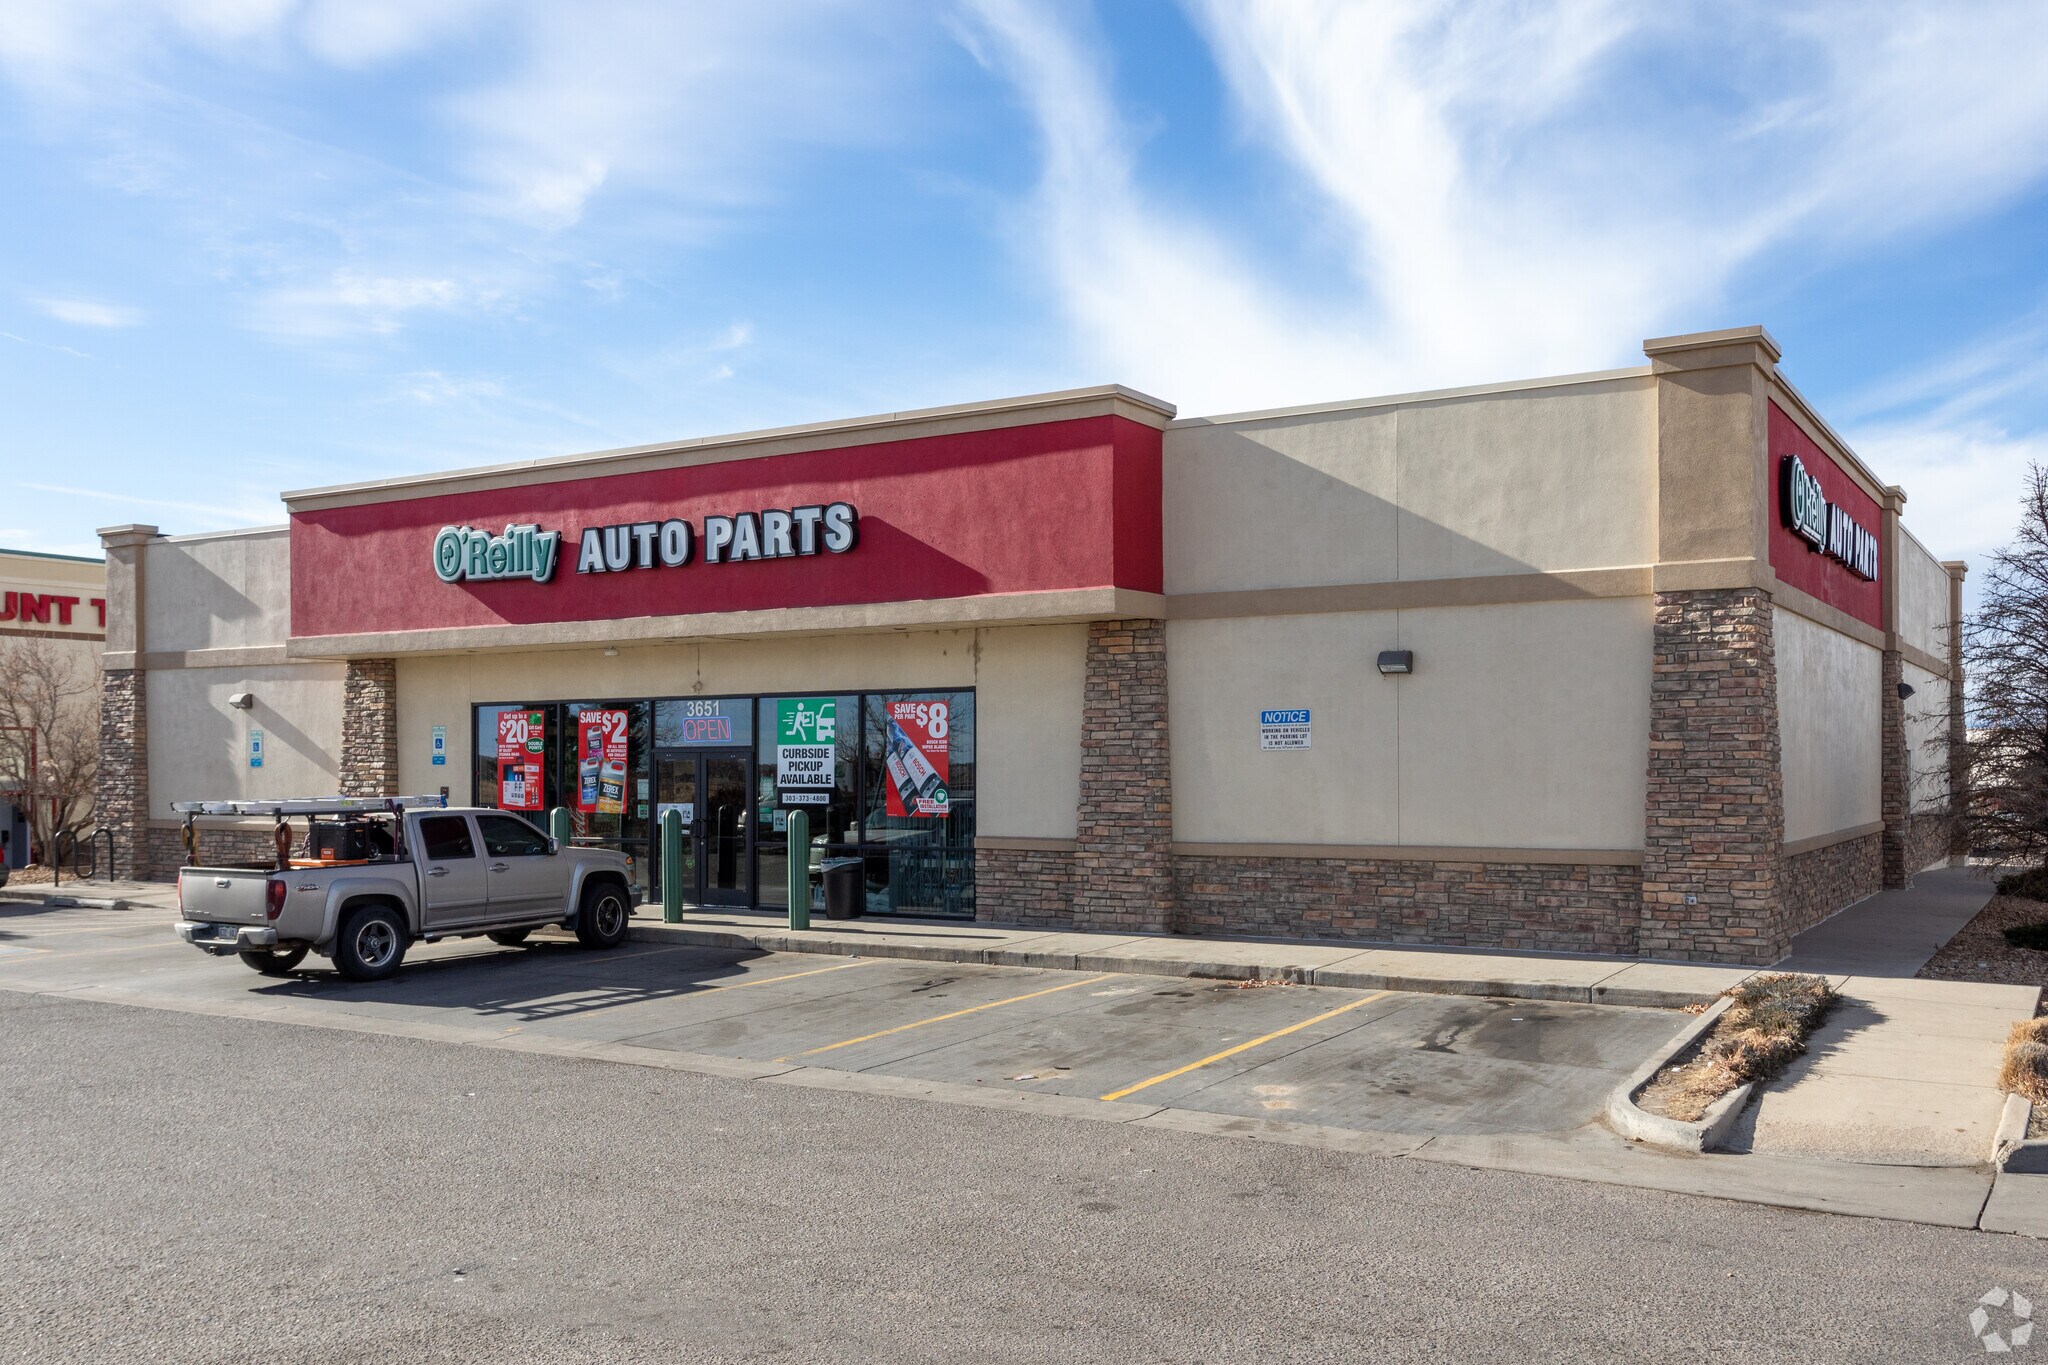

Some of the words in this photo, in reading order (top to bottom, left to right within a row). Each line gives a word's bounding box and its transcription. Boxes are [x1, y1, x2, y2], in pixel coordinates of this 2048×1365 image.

[436, 525, 557, 582] O'Reilly
[577, 518, 694, 574] AUTO
[704, 501, 857, 564] PARTS
[1830, 503, 1853, 566] AUTO
[1855, 522, 1878, 582] PARTS
[687, 700, 719, 716] 3651
[1264, 711, 1307, 722] NOTICE
[580, 712, 601, 723] SAVE
[602, 712, 627, 743] $2
[685, 719, 730, 740] OPEN
[894, 703, 916, 713] SAVE
[916, 703, 948, 738] $8
[500, 719, 528, 743] $20
[782, 748, 829, 758] CURBSIDE
[788, 761, 823, 771] PICKUP
[895, 760, 906, 778] BOSCH
[912, 758, 926, 776] BOSCH
[584, 776, 596, 784] ZEREX
[780, 774, 831, 784] AVAILABLE
[603, 783, 619, 794] ZEREX
